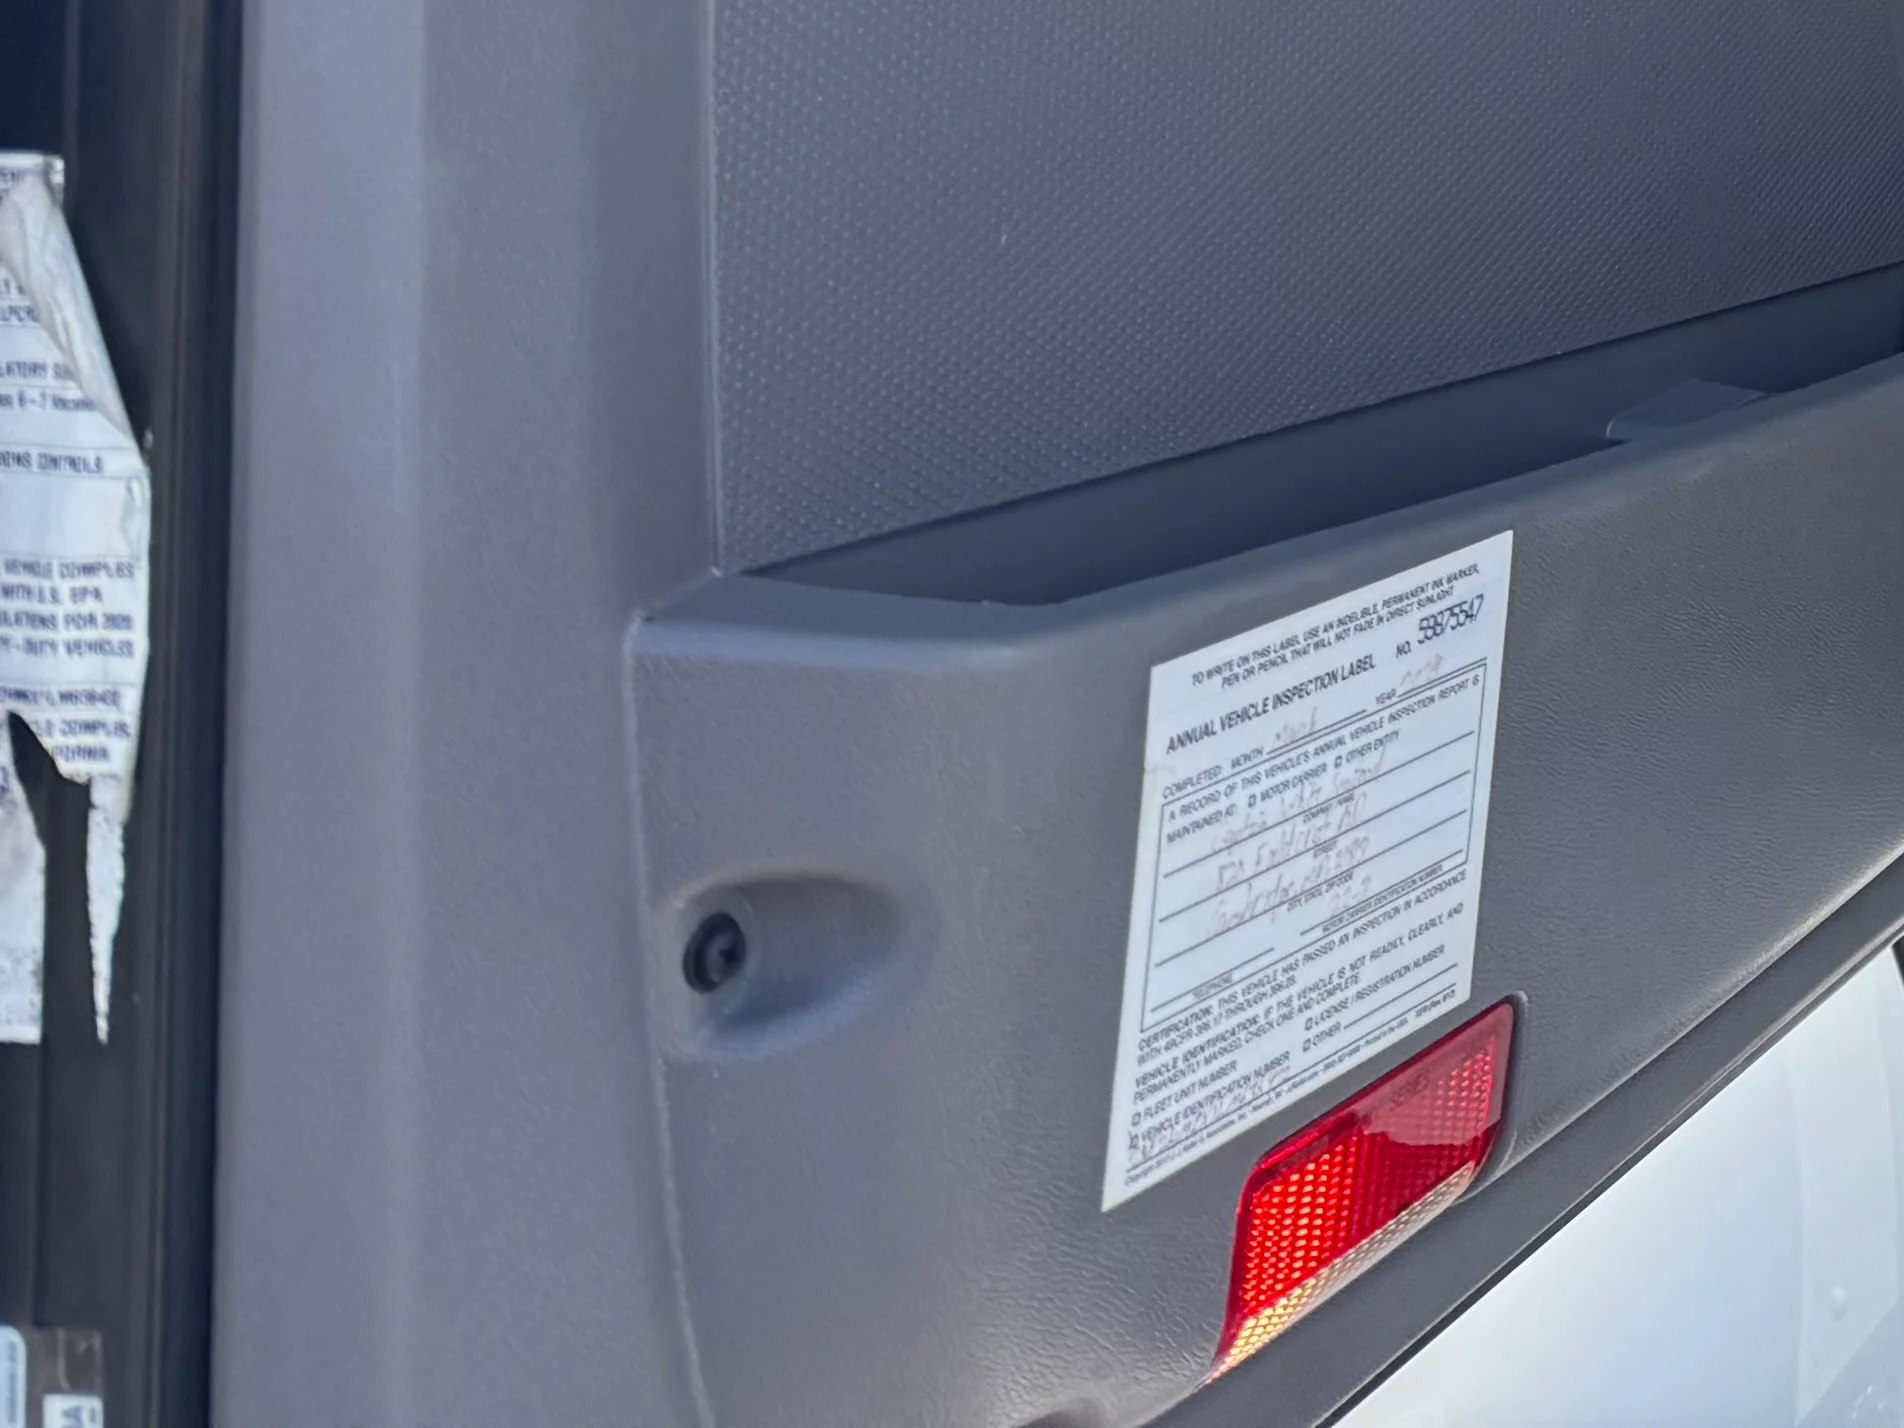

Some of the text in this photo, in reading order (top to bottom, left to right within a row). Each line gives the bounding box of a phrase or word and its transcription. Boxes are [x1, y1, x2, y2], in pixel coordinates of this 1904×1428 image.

[1166, 718, 1218, 755] ANNUAL
[1219, 697, 1269, 733] VEHICLE
[1271, 669, 1338, 711] INSPECTION
[1339, 653, 1376, 683] LABEL
